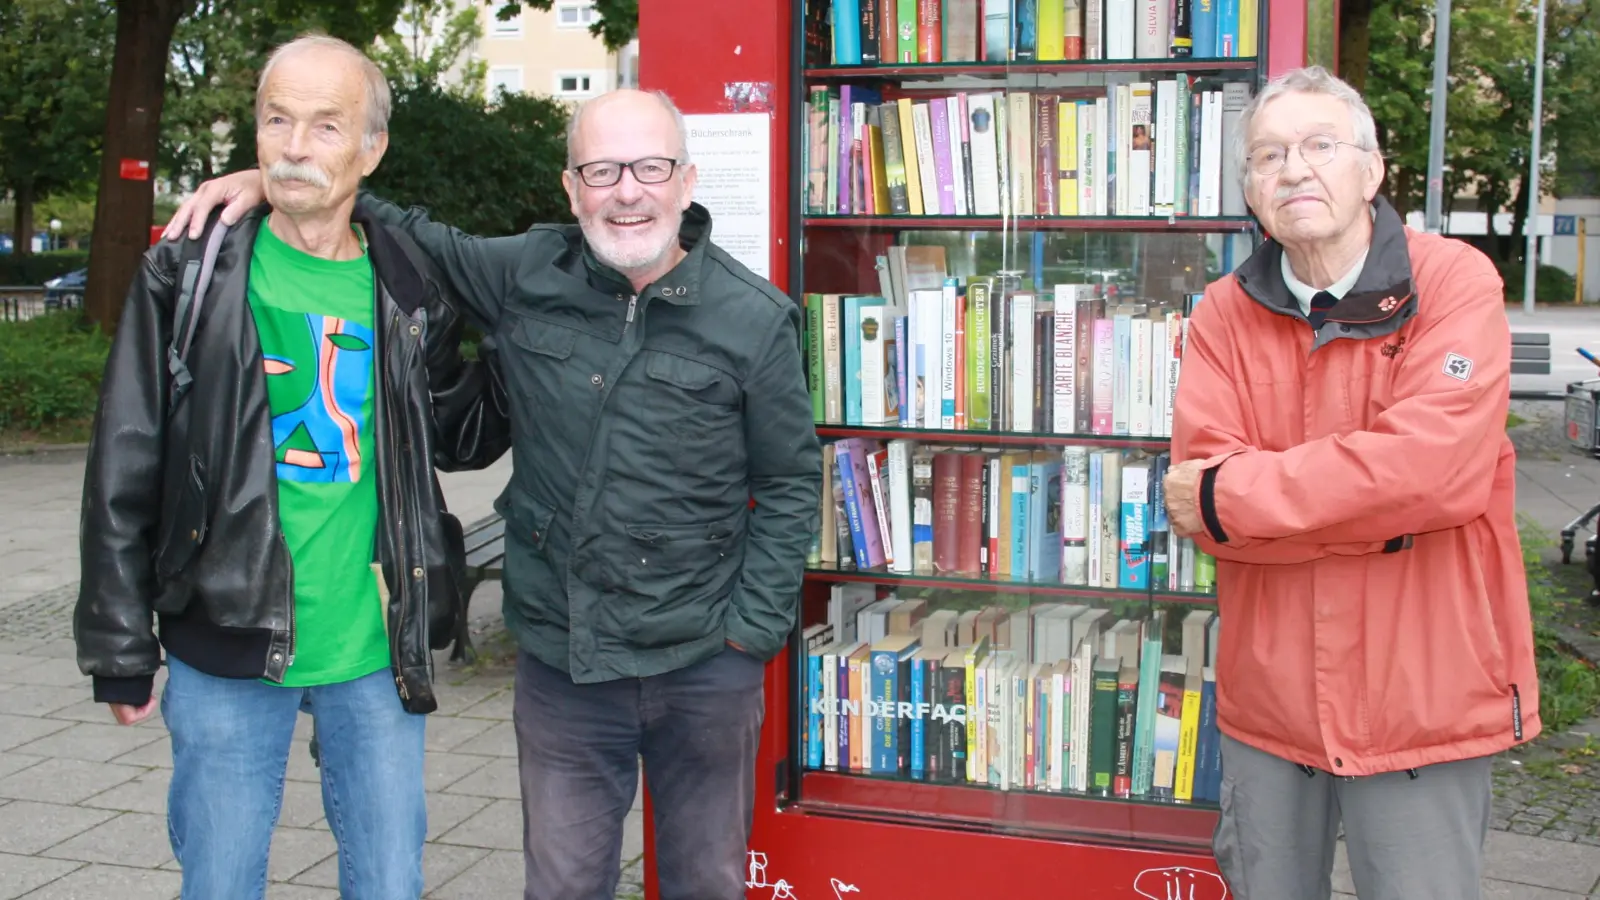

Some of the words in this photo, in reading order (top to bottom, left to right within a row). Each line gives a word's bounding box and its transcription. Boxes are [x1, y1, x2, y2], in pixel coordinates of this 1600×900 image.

[1148, 6, 1157, 35] SILVIA
[1040, 106, 1051, 148] Spionin
[827, 303, 837, 329] Hand
[1055, 310, 1073, 358] BLANCHE
[944, 333, 952, 345] 10
[976, 288, 986, 394] HUNDEGESCHICHTEN
[944, 348, 952, 391] Windows
[1055, 362, 1072, 396] CARTE
